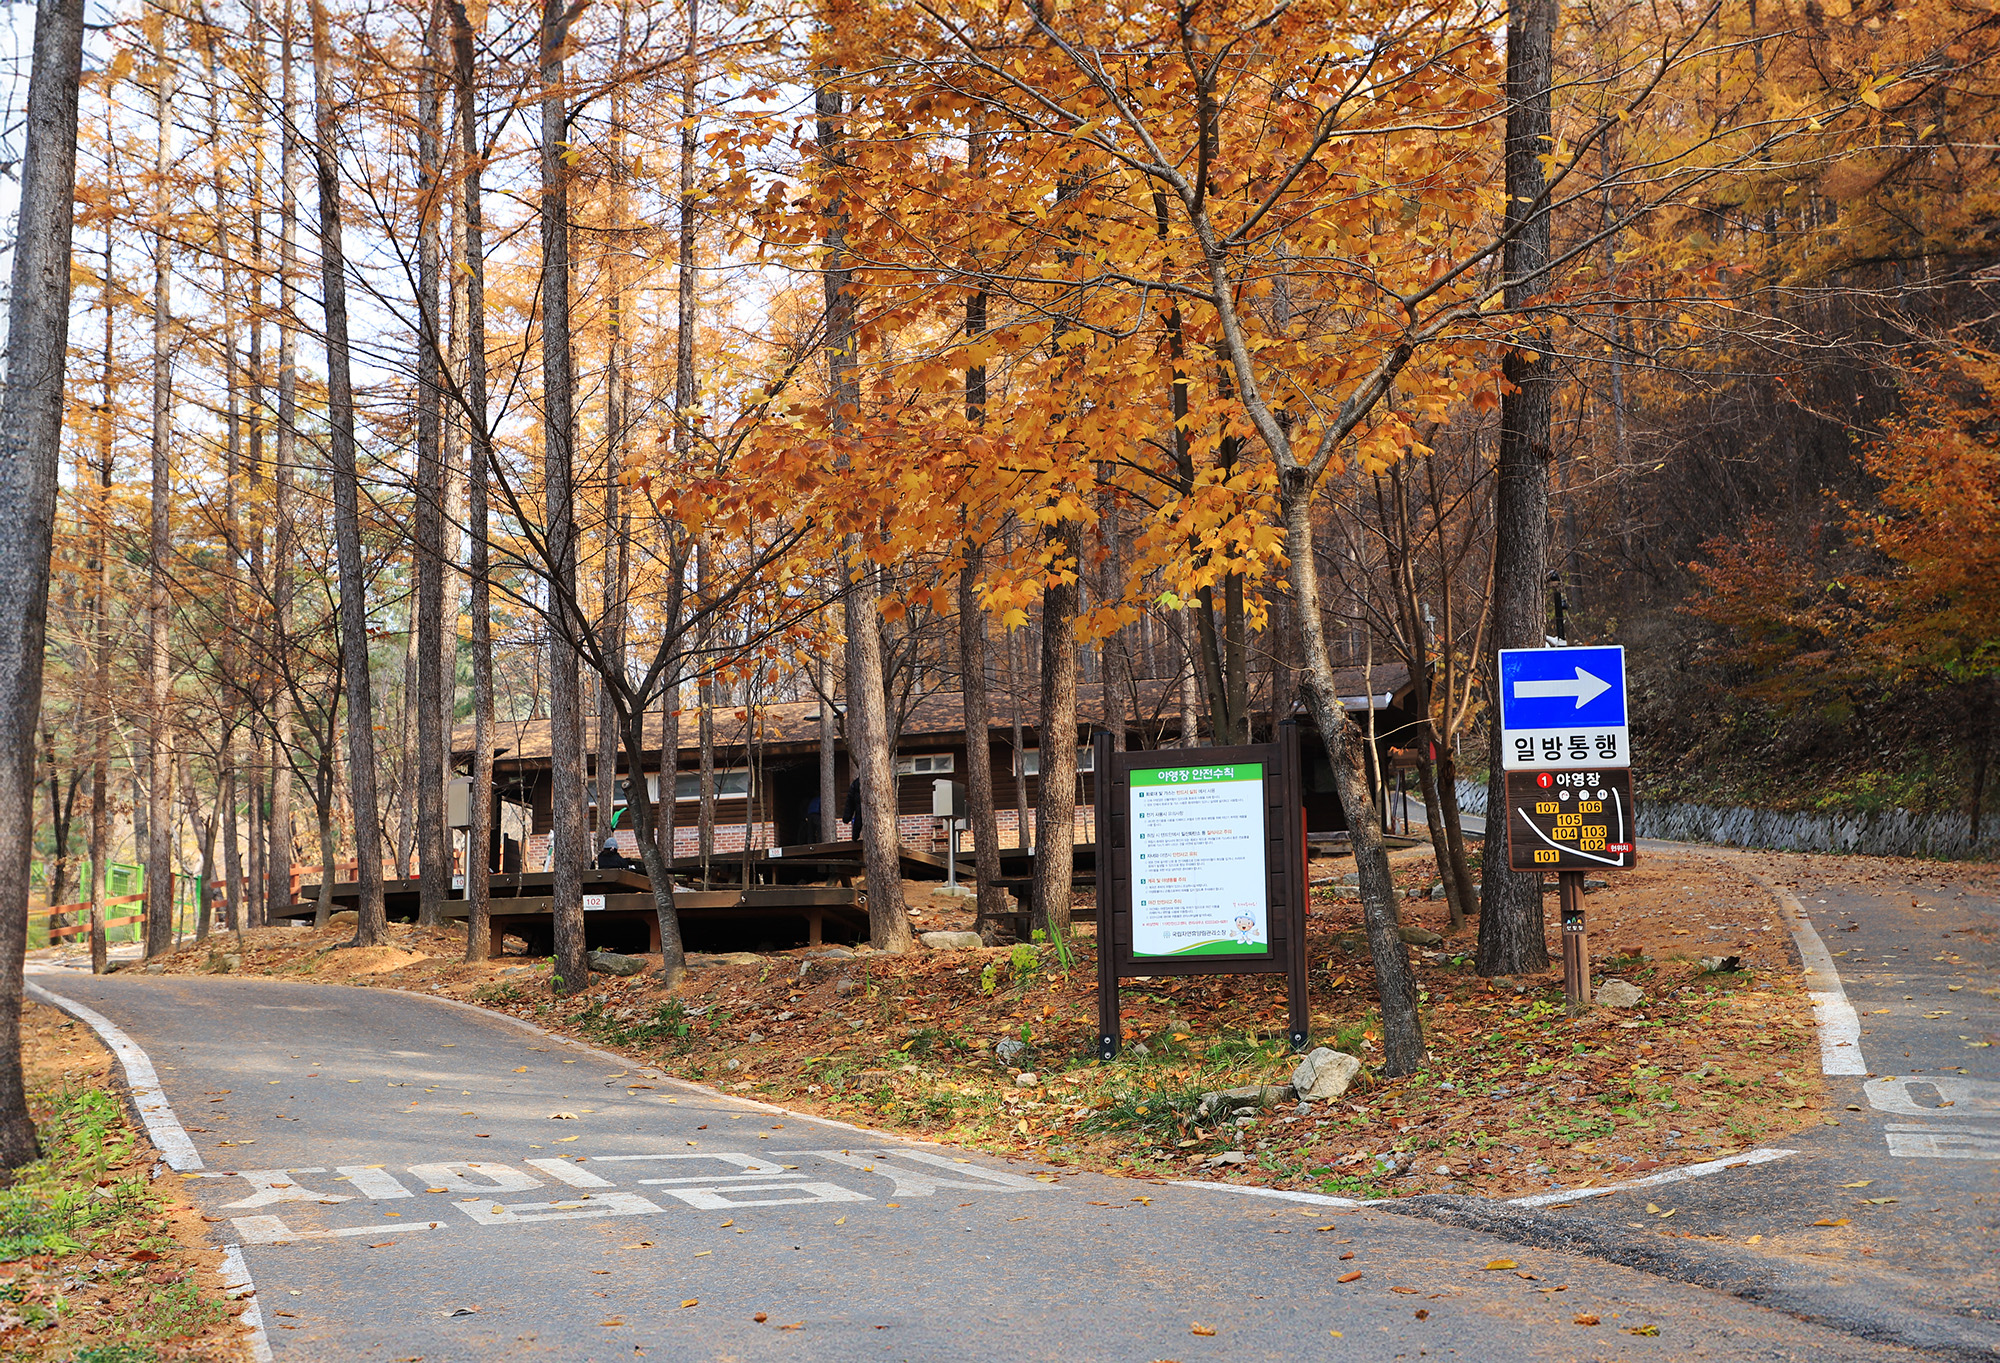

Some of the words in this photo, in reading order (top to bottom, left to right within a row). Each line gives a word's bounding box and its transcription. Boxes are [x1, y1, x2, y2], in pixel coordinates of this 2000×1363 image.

[1514, 733, 1618, 762] 일방통행
[1158, 769, 1189, 782] 야영장
[1192, 767, 1234, 780] 안전수칙
[1556, 772, 1601, 787] 야영장
[1537, 803, 1558, 814] 107
[1580, 802, 1601, 812] 106
[1558, 815, 1581, 825] 105
[1554, 829, 1576, 839] 104
[1583, 826, 1606, 837] 103
[1582, 839, 1604, 850] 102
[1610, 844, 1629, 852] 현위치
[1536, 851, 1557, 862] 101
[586, 898, 601, 906] 102
